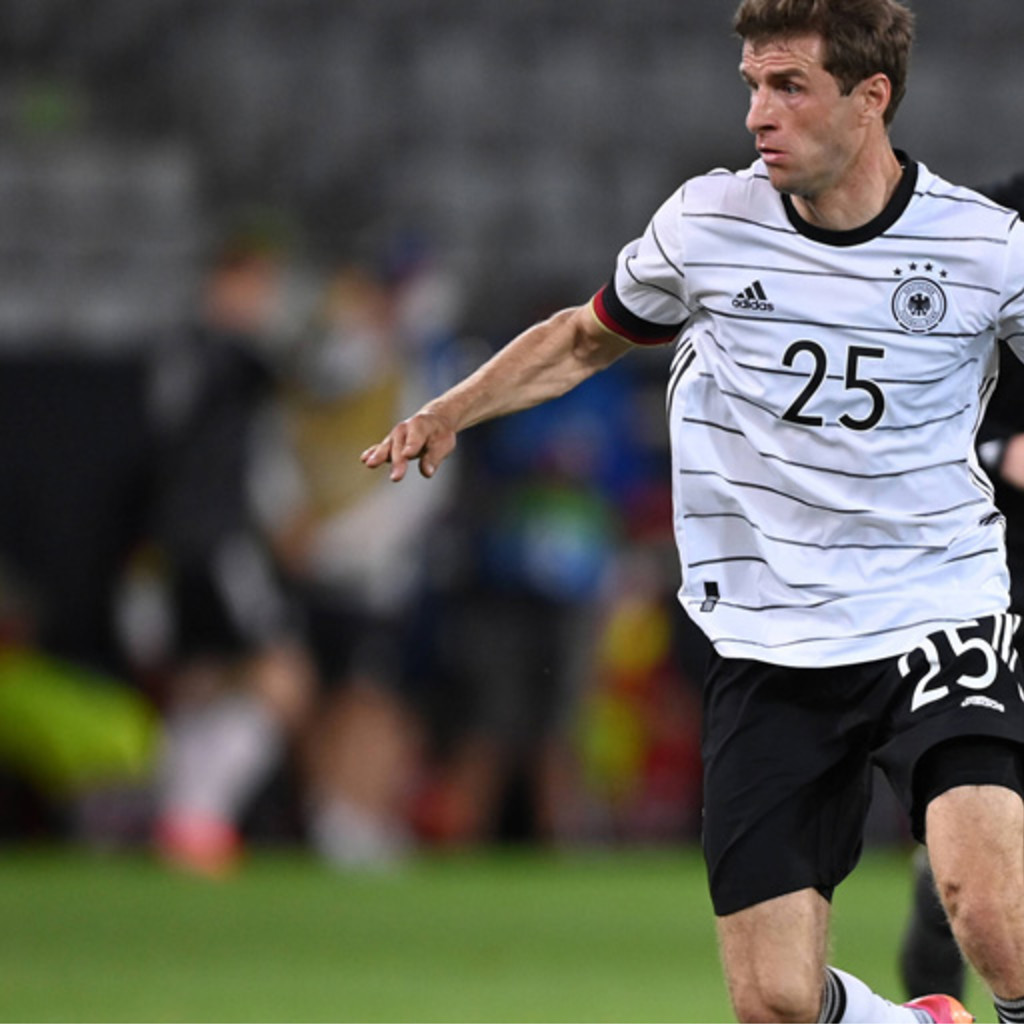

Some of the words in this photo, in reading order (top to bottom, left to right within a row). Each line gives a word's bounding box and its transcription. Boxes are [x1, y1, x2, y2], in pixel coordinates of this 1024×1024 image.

[731, 298, 775, 312] adidas
[781, 339, 885, 431] 25
[897, 619, 998, 713] 25
